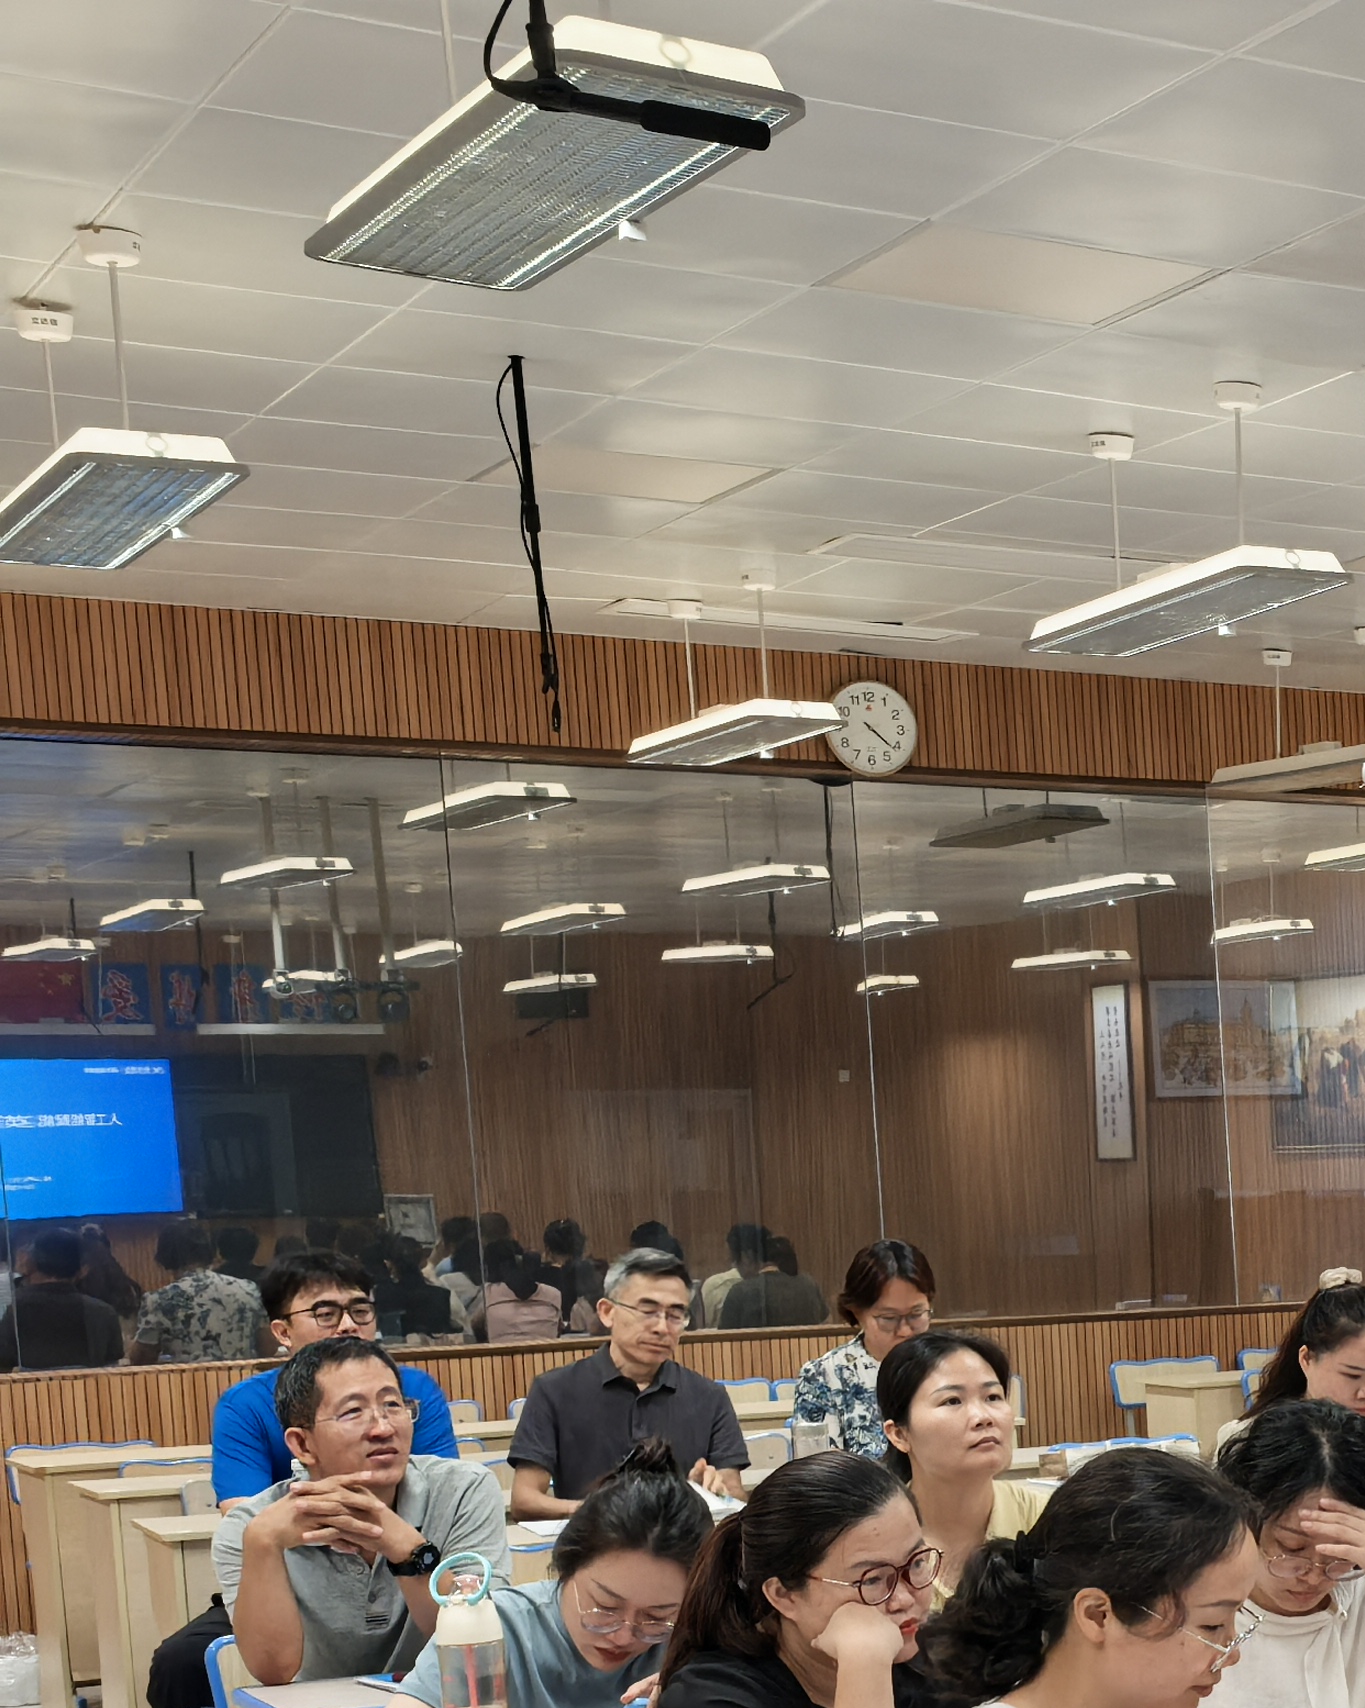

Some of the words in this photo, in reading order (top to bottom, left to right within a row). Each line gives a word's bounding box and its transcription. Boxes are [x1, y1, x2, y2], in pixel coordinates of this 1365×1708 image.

[849, 694, 860, 706] 11
[861, 691, 875, 703] 12
[837, 706, 851, 717] 10
[891, 709, 900, 720] 2
[896, 724, 905, 736] 3
[841, 737, 850, 748] 8
[853, 749, 861, 760] 7
[867, 754, 876, 766] 6
[883, 751, 891, 762] 5
